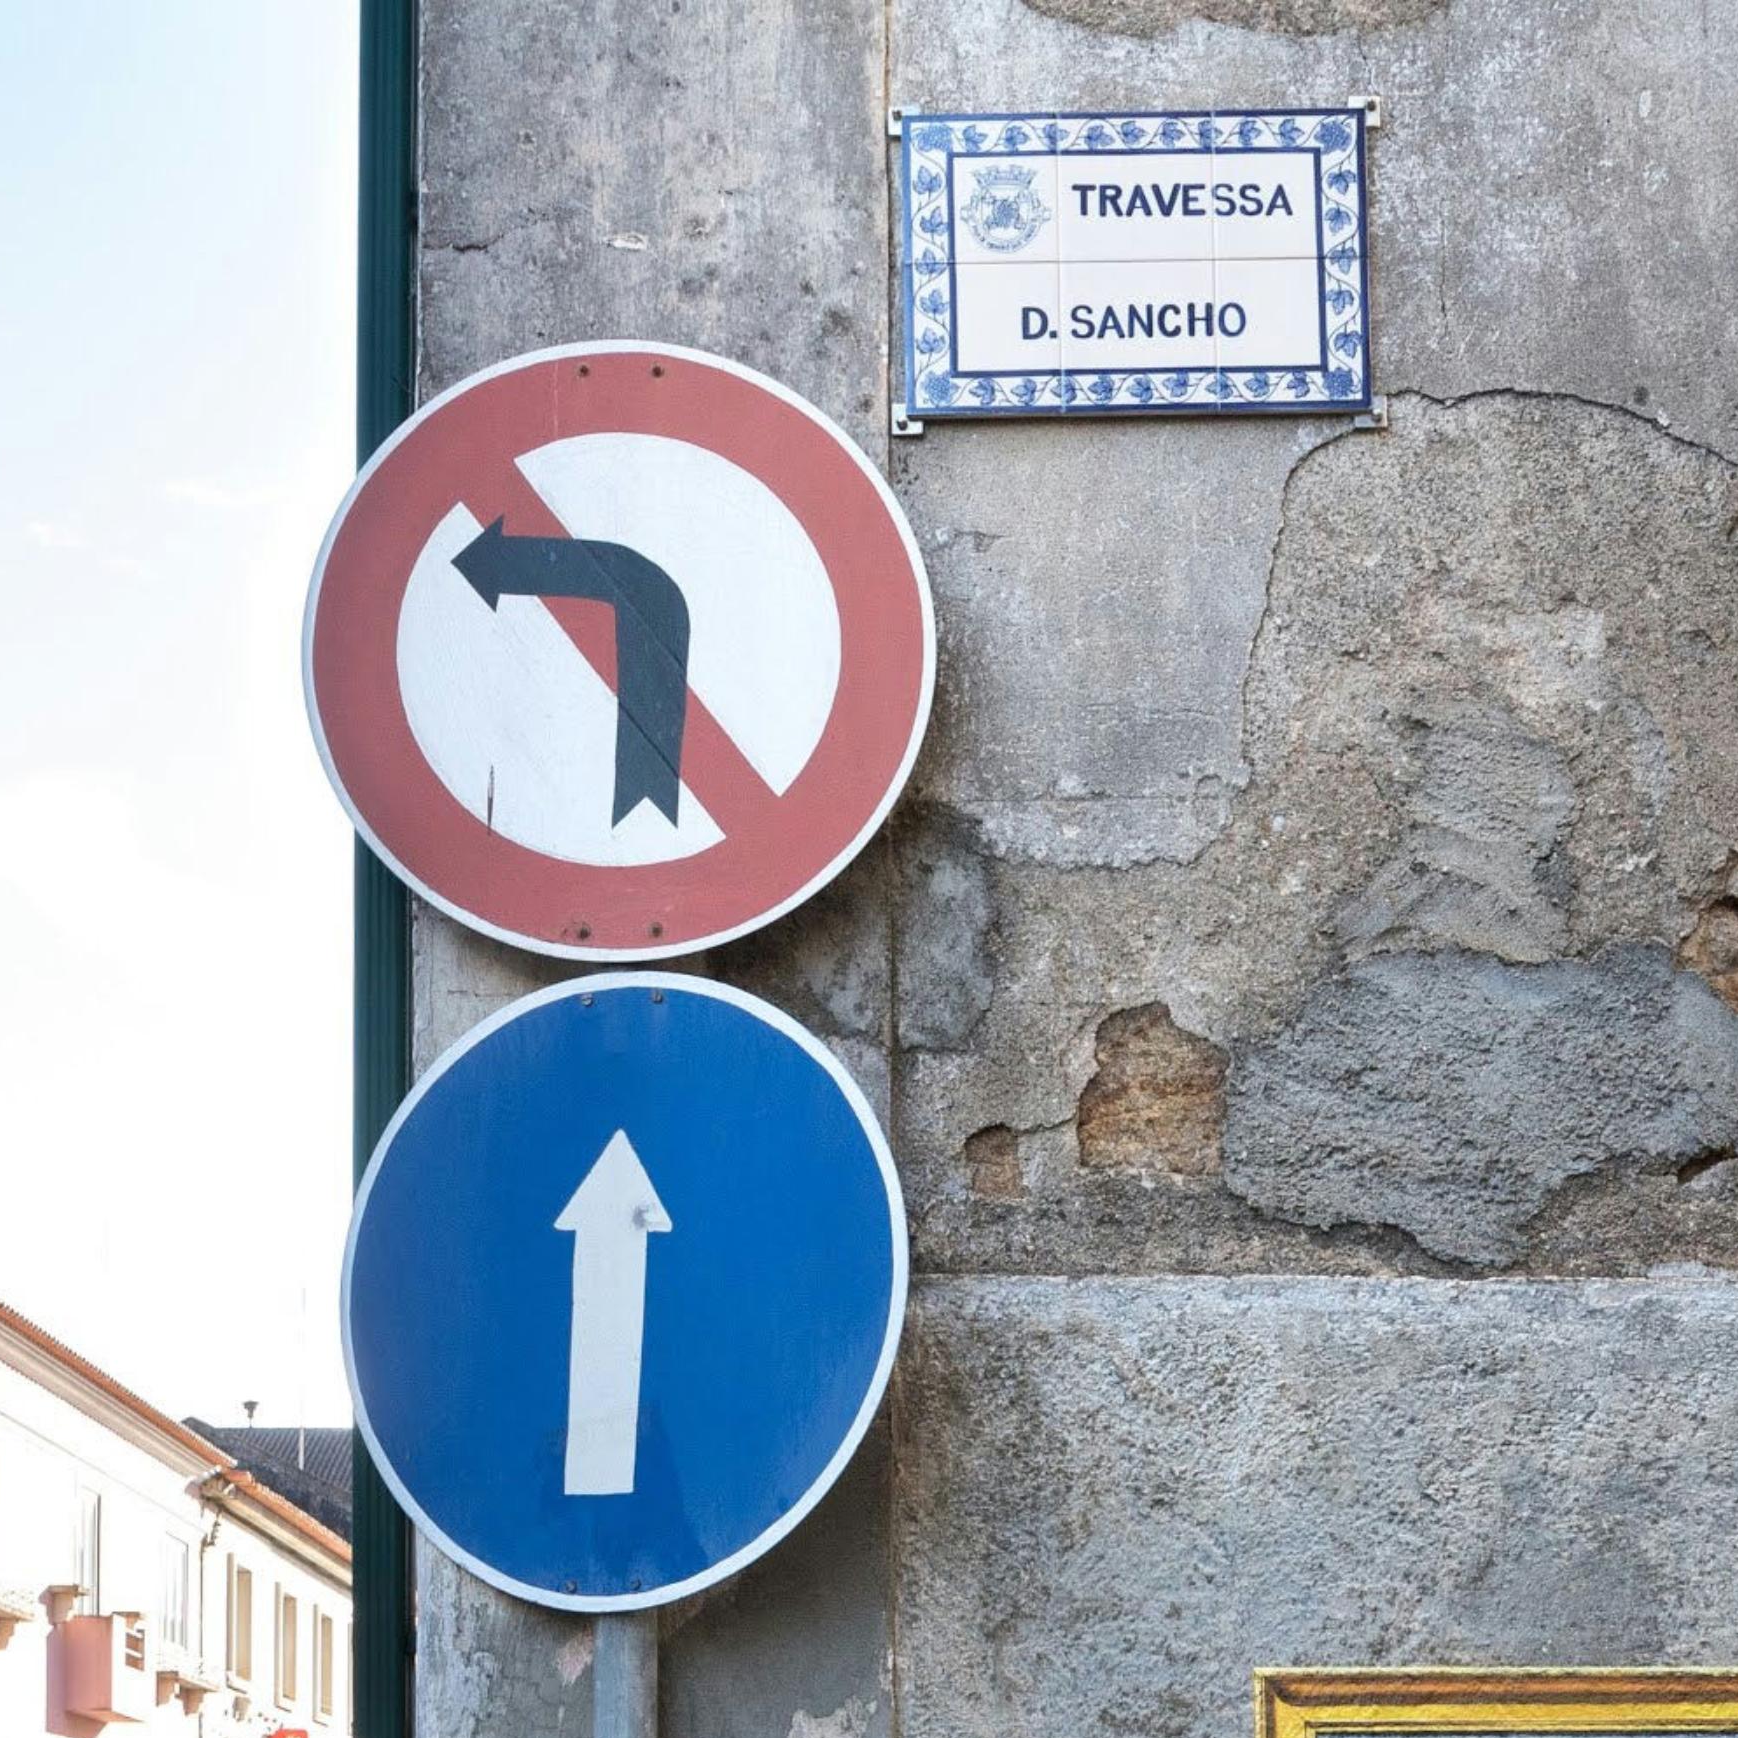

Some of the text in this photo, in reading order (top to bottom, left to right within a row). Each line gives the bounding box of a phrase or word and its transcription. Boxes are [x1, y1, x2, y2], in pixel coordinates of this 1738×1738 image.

[1071, 182, 1294, 218] TRAVESSA
[1020, 302, 1247, 341] D. SANCHO
